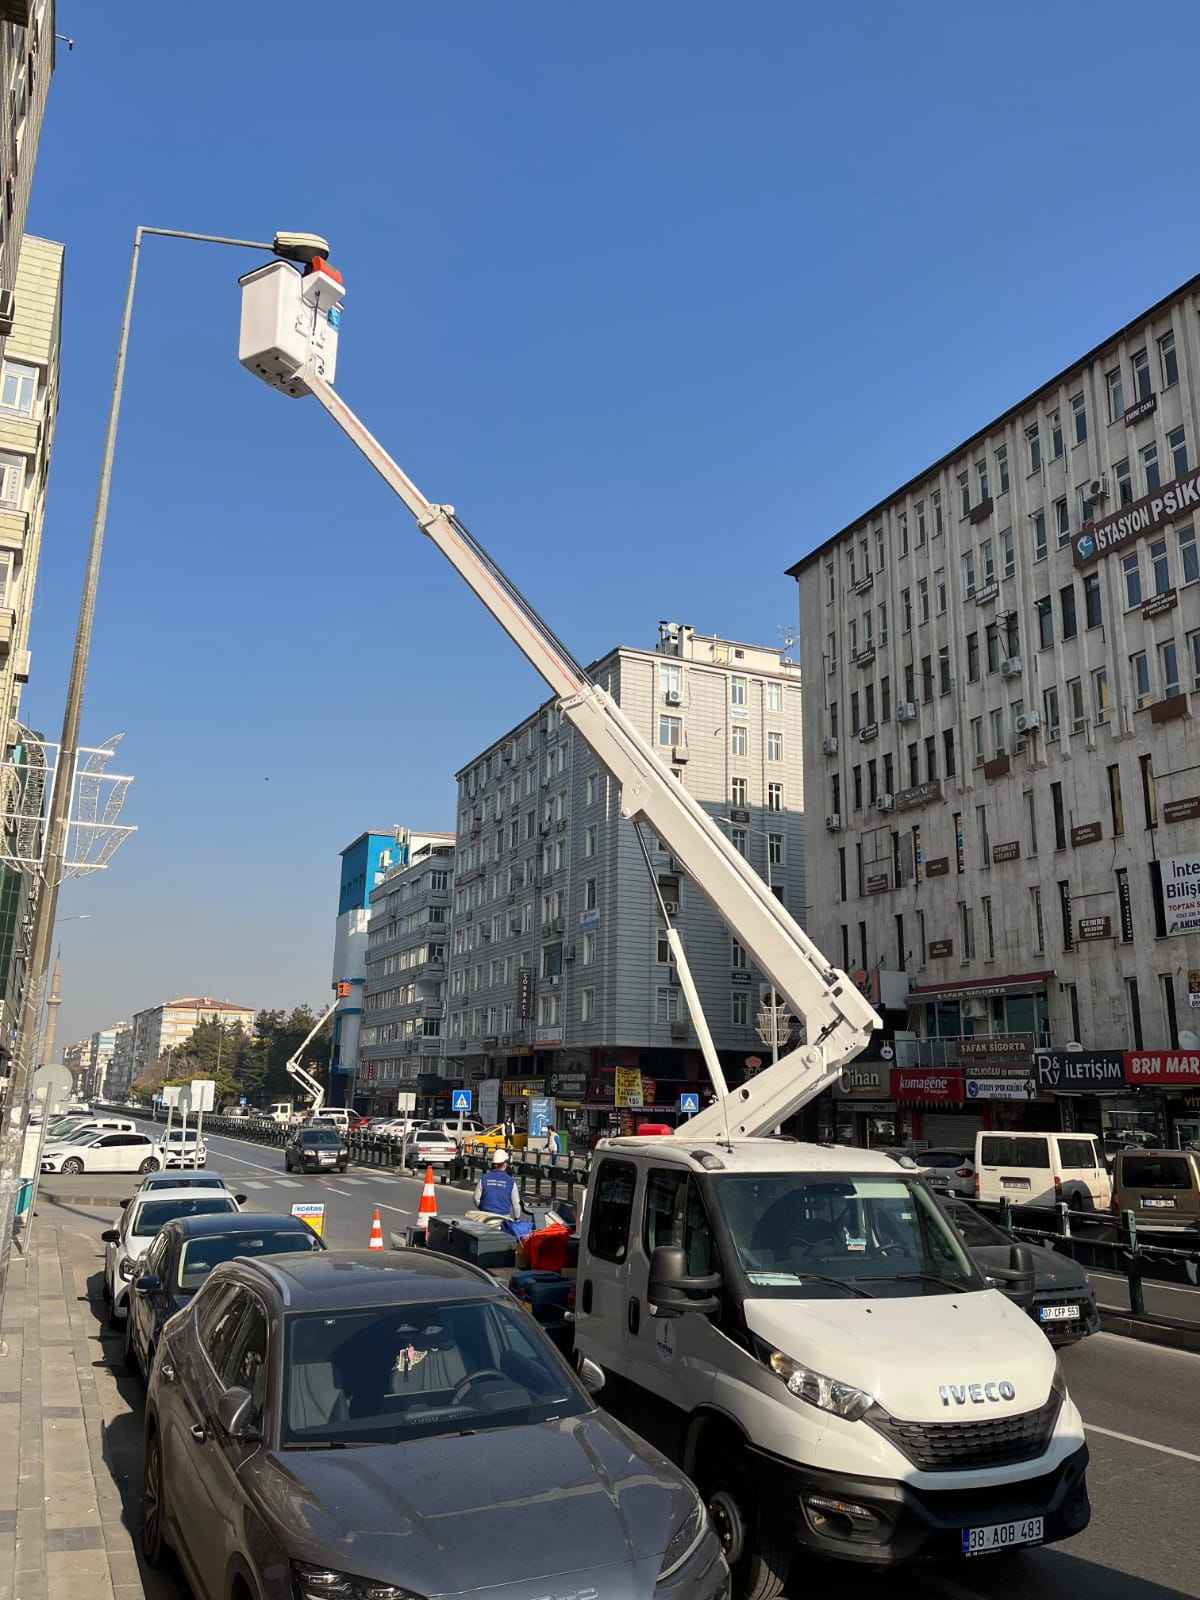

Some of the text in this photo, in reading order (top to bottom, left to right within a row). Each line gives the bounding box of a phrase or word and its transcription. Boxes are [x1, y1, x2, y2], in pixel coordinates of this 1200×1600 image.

[1093, 505, 1150, 551] İSTASYON
[1064, 1059, 1122, 1080] İLETİŞİM
[1131, 1057, 1161, 1075] BRN
[898, 1074, 948, 1093] komagene
[938, 1381, 1016, 1407] IVECO
[970, 1518, 1042, 1549] 38 AOB 483
